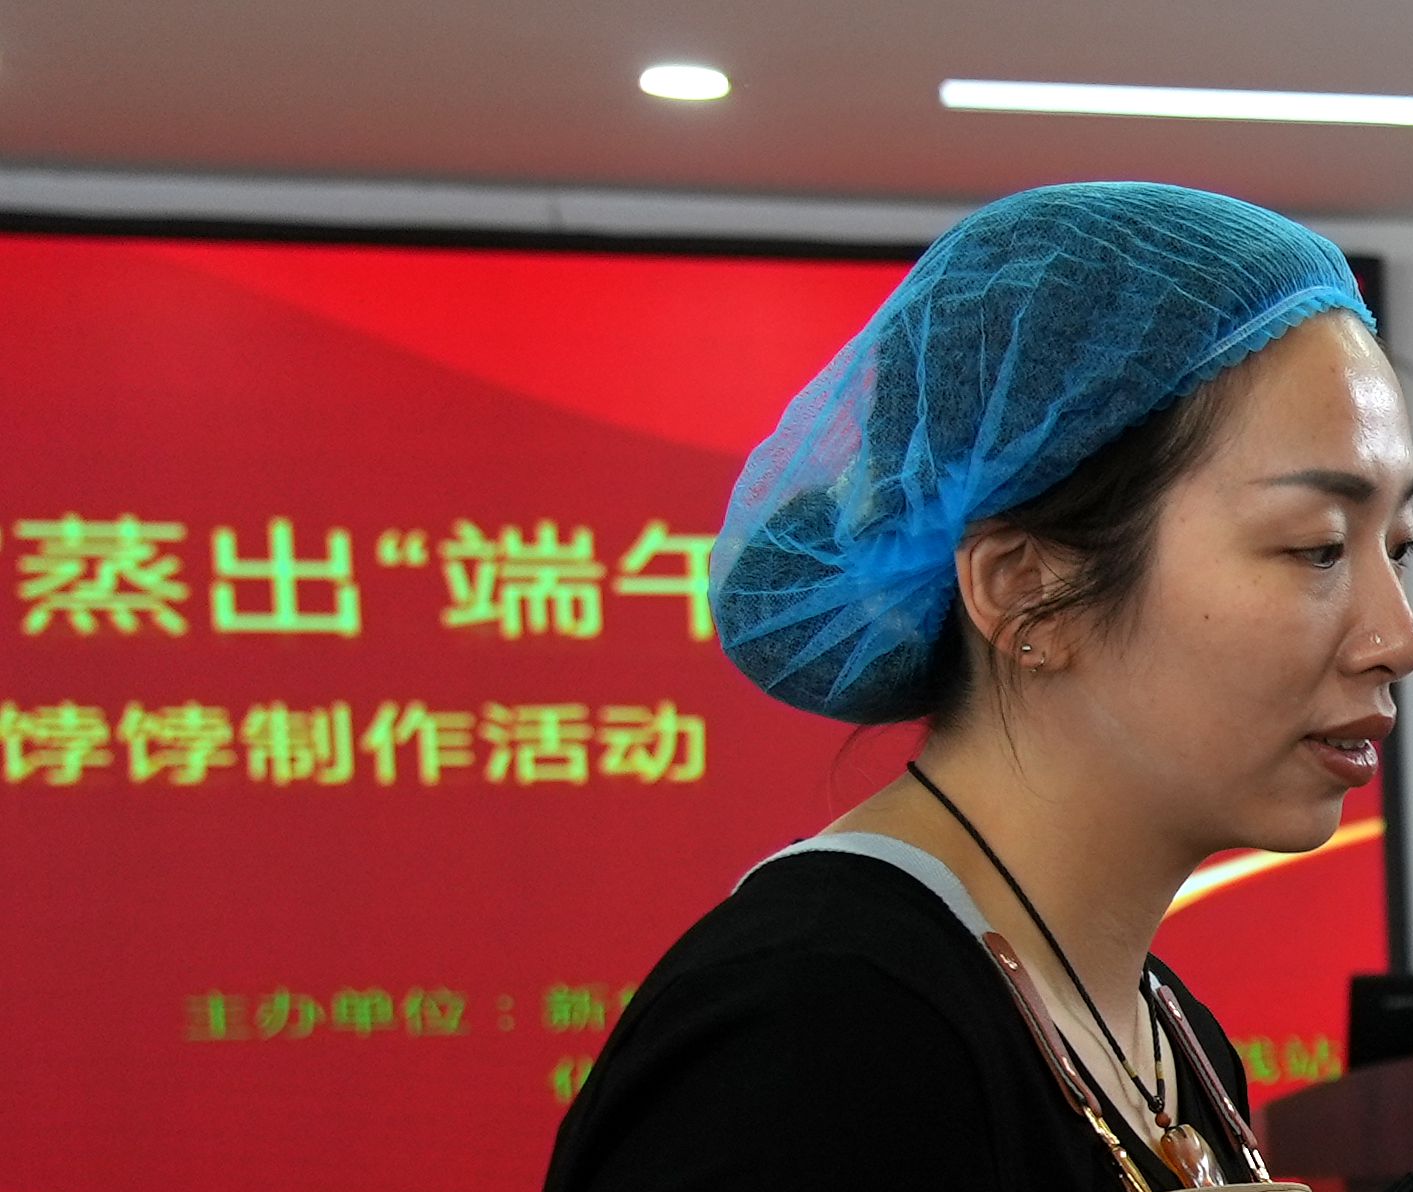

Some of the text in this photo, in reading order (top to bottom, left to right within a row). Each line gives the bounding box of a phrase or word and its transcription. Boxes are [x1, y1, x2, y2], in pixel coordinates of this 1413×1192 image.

[0, 699, 708, 786] 饽饽制作活动
